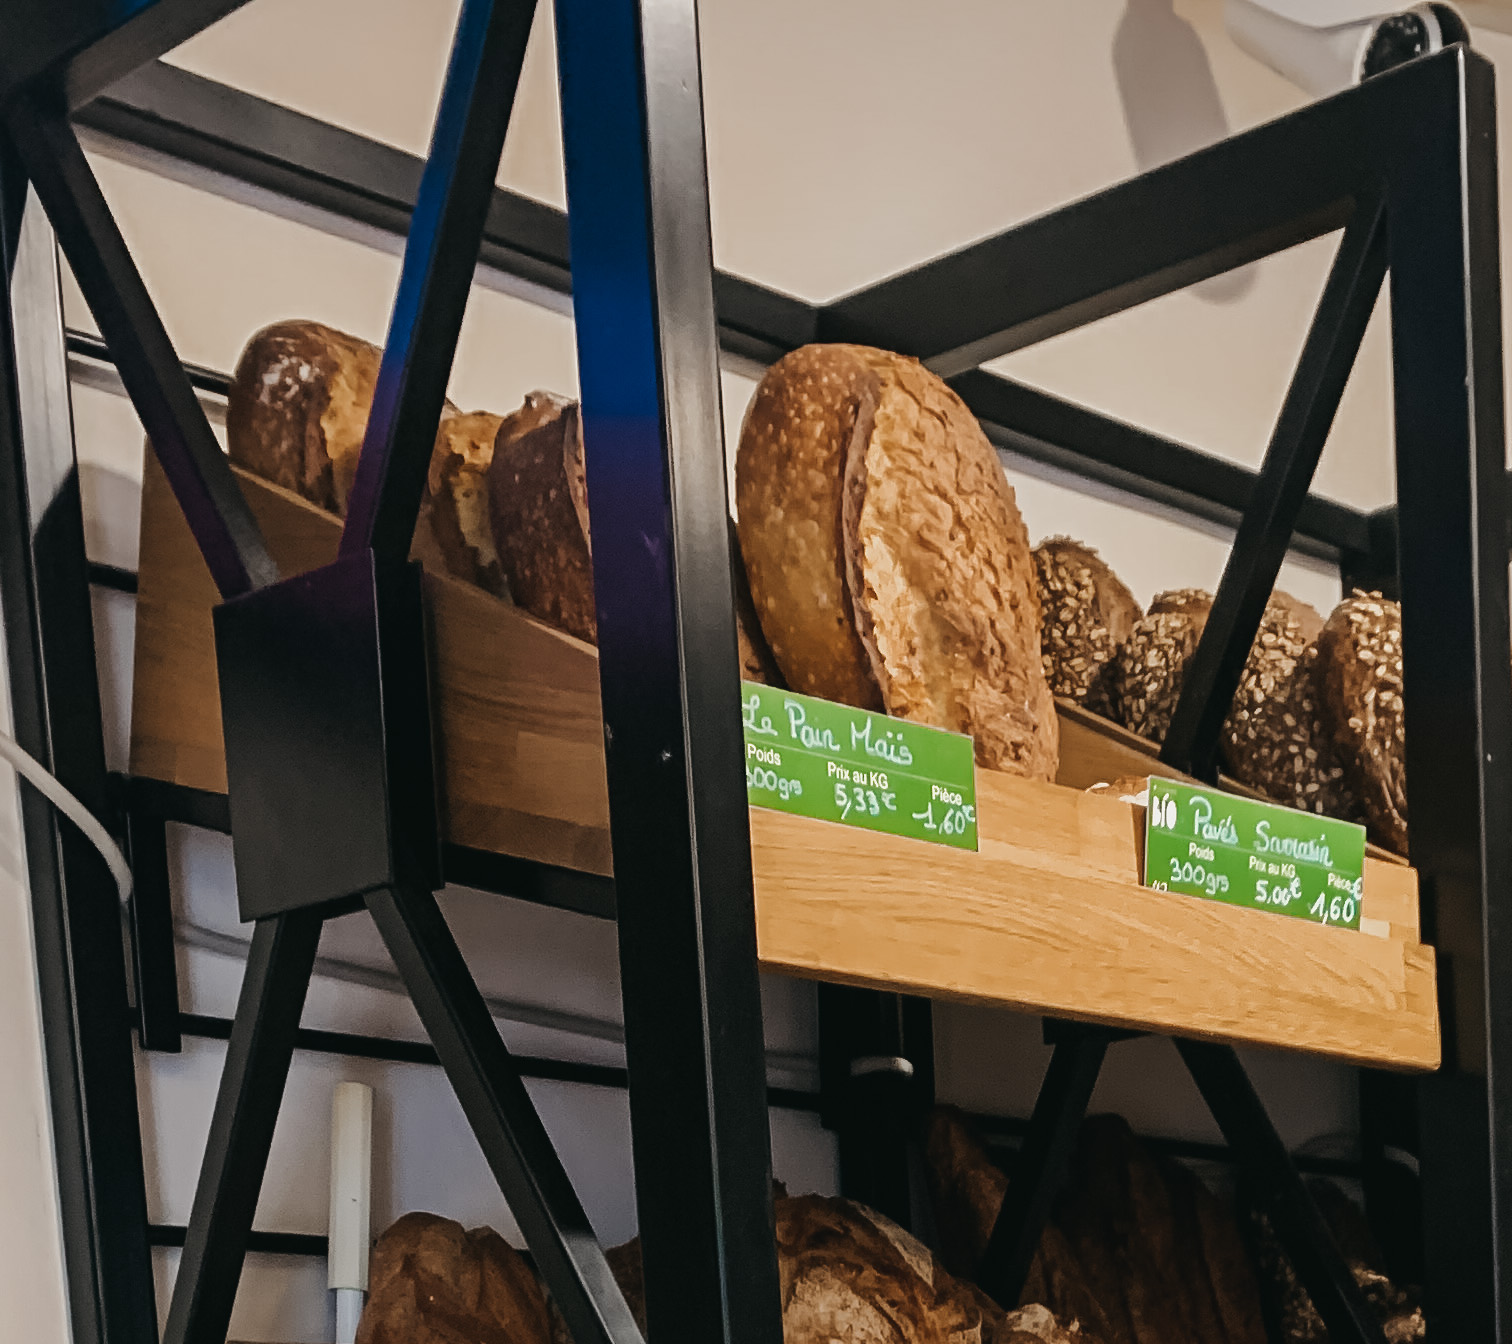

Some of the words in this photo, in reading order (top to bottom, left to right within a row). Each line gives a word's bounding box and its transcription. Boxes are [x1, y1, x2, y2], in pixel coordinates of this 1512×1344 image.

[742, 694, 778, 736] Le
[784, 698, 840, 751] Pain
[851, 716, 913, 766] Maïs
[747, 743, 781, 766] Poids
[828, 761, 850, 782] Prix
[852, 770, 868, 785] au
[869, 771, 888, 789] KG
[931, 785, 962, 806] Pièce
[1189, 842, 1214, 861] Poids
[1249, 855, 1266, 873] Prix
[1267, 863, 1279, 875] au
[1281, 864, 1296, 878] KG
